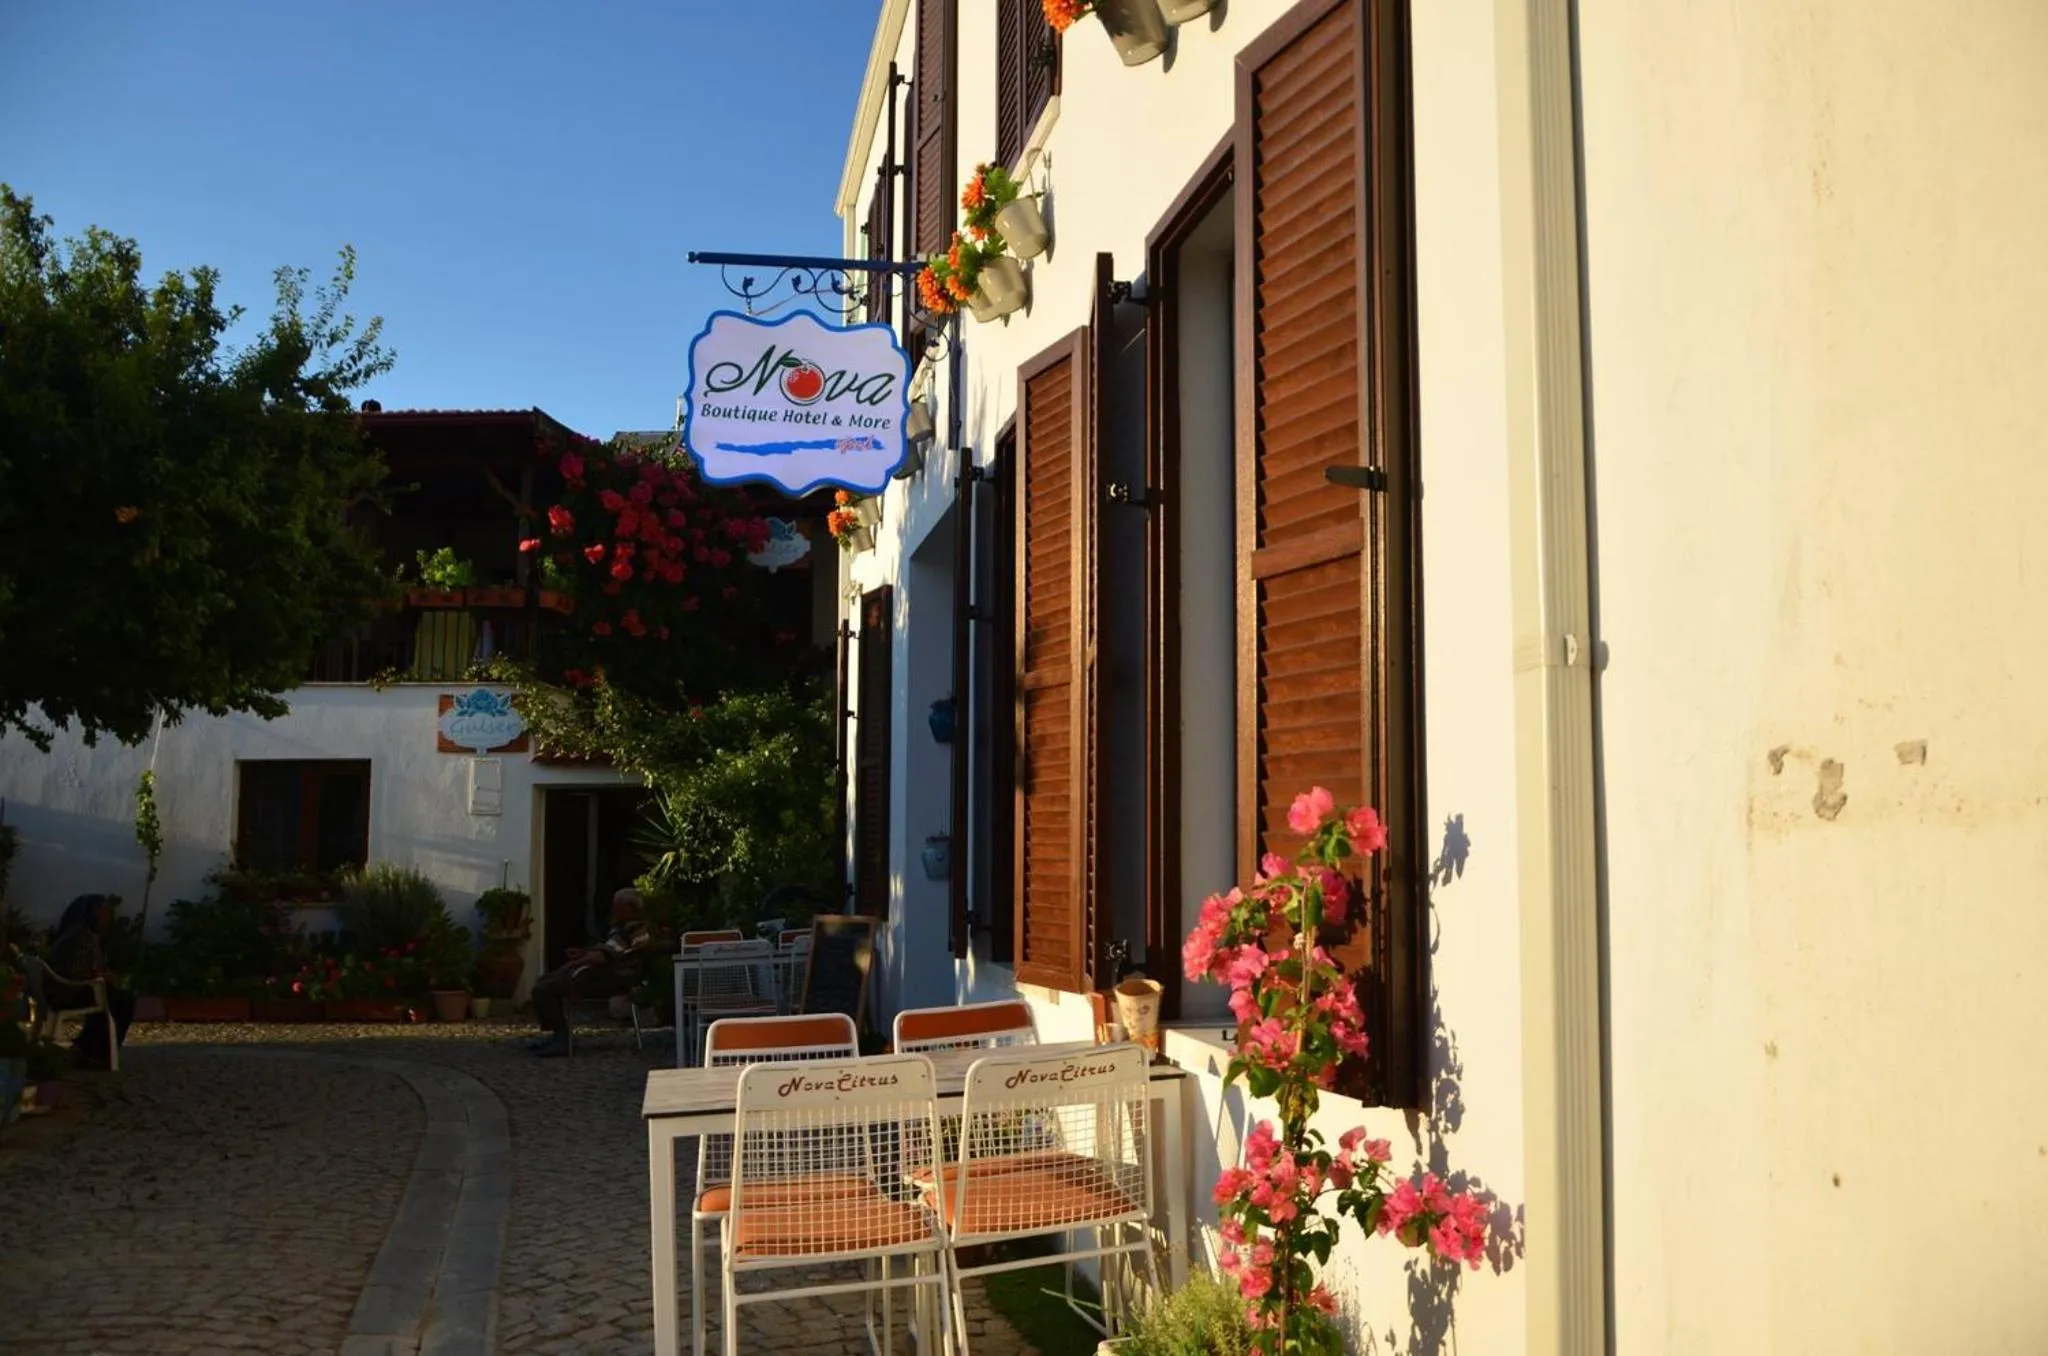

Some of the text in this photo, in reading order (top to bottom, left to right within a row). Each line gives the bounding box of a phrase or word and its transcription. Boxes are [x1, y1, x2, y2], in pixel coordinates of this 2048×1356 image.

[703, 344, 896, 406] Nova
[700, 403, 891, 429] Boutique Hotel & More
